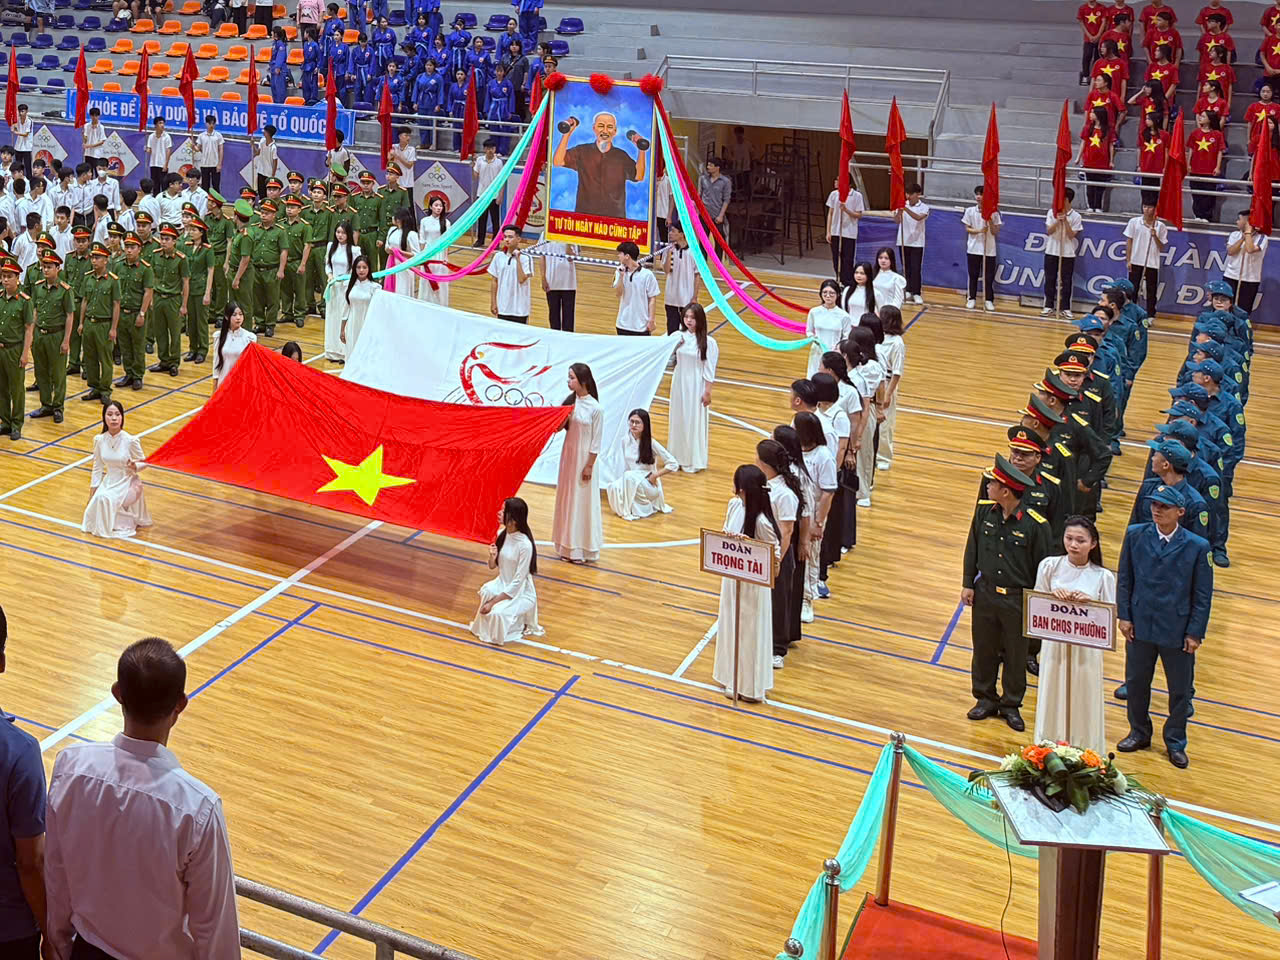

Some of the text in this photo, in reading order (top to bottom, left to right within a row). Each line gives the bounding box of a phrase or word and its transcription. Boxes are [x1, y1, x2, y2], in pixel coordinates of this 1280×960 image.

[120, 97, 137, 118] ĐỂ
[222, 106, 248, 127] BẢO
[270, 109, 288, 131] TỔ
[290, 112, 327, 135] QUỐC
[1024, 232, 1127, 261] ĐNG
[722, 540, 752, 555] ĐOÀN
[711, 551, 763, 575] TRỌNG TÀI
[1050, 603, 1089, 618] ĐOÀN
[1032, 614, 1107, 640] BAN CHQS PHƯỜNG
